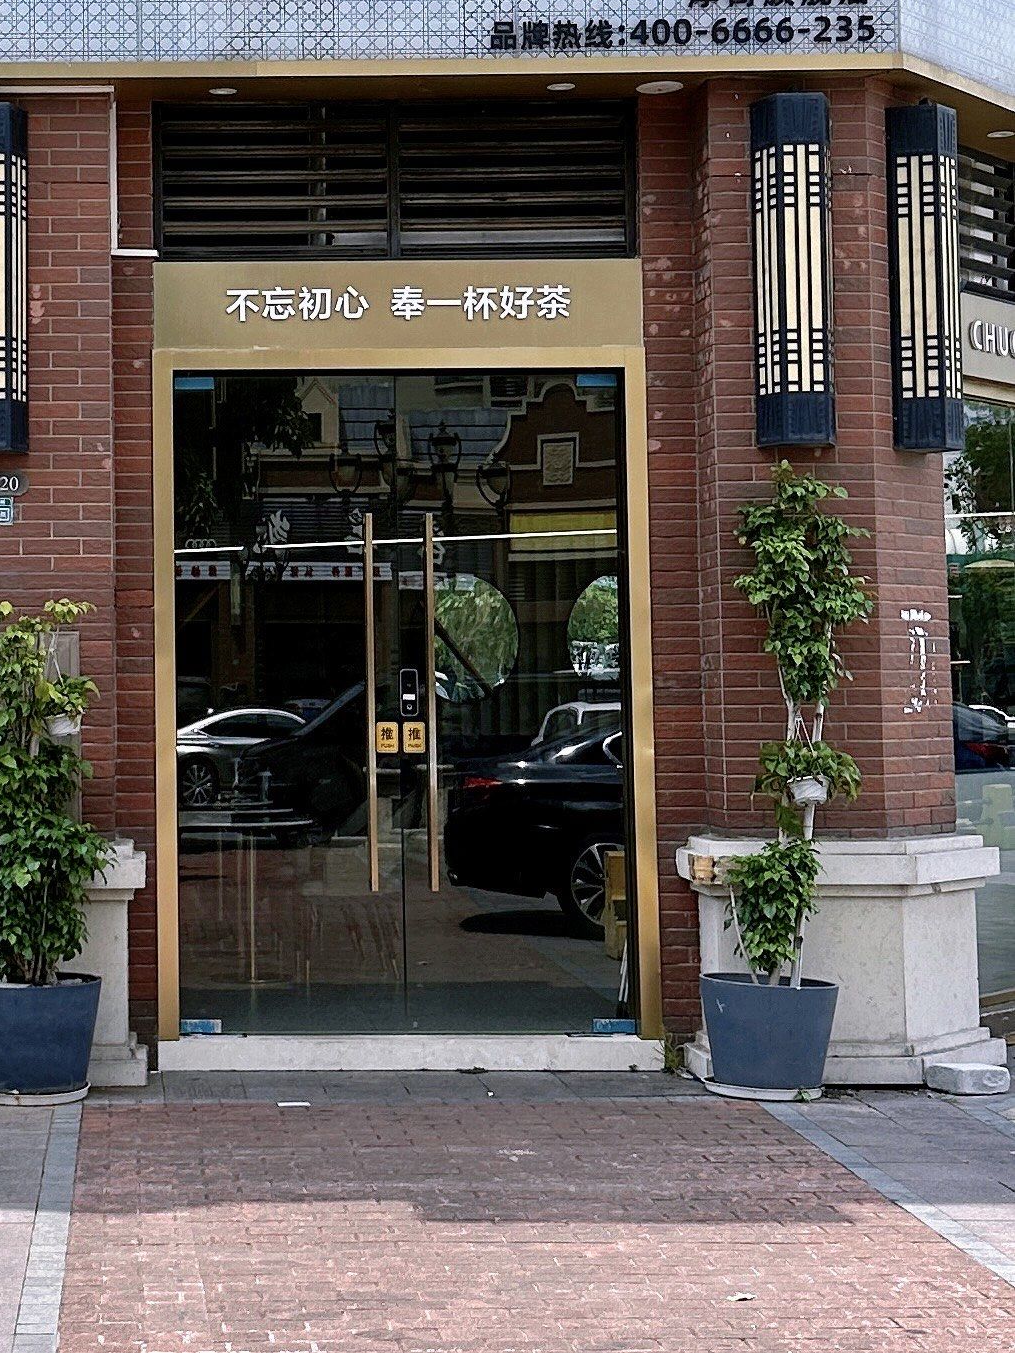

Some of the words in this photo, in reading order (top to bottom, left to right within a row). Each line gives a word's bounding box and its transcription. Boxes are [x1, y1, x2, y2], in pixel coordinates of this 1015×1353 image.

[225, 286, 370, 322] 不忘初心
[390, 284, 571, 321] 奉一杯好茶
[969, 319, 1015, 359] CHU
[381, 727, 394, 741] 推
[408, 727, 421, 741] 推
